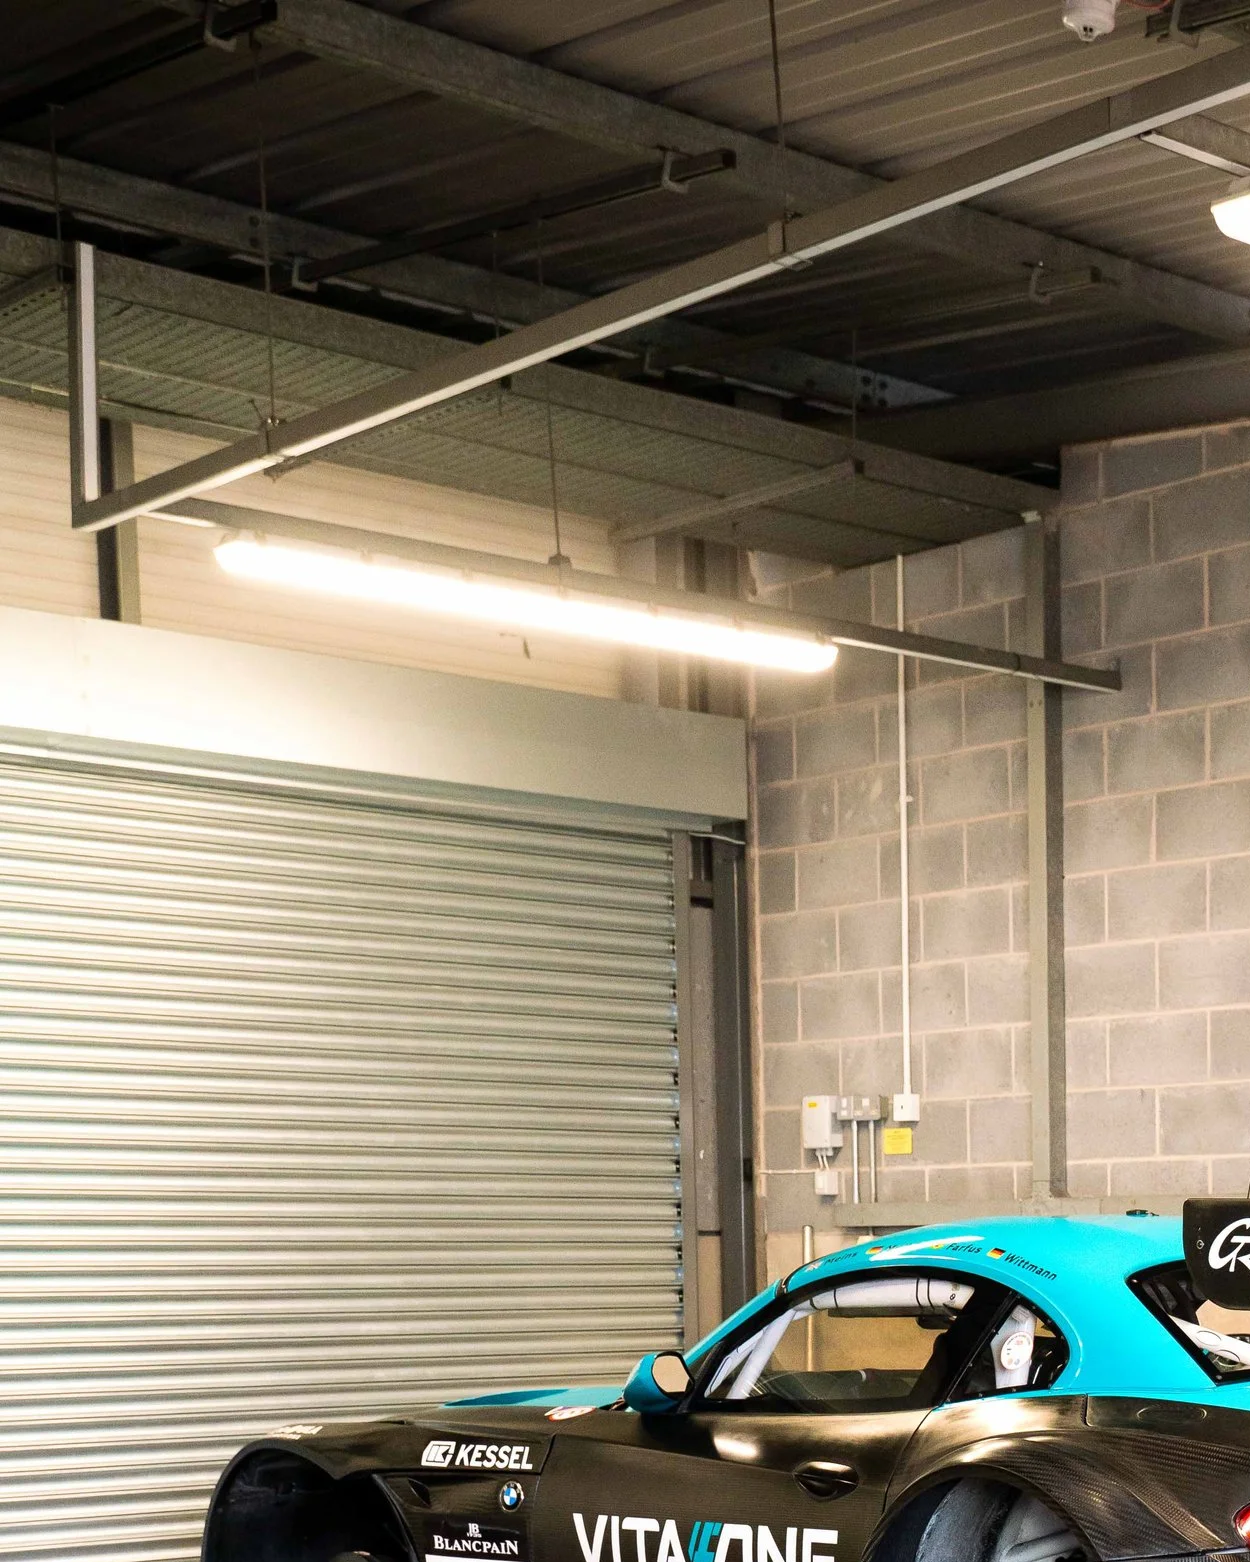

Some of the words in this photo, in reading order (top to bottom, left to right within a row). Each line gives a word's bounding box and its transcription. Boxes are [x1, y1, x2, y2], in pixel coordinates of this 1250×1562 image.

[946, 1243, 983, 1254] Farfus
[1004, 1253, 1058, 1281] Wittmann
[455, 1444, 533, 1470] KESSEL
[433, 1535, 519, 1555] BLANCPAIN
